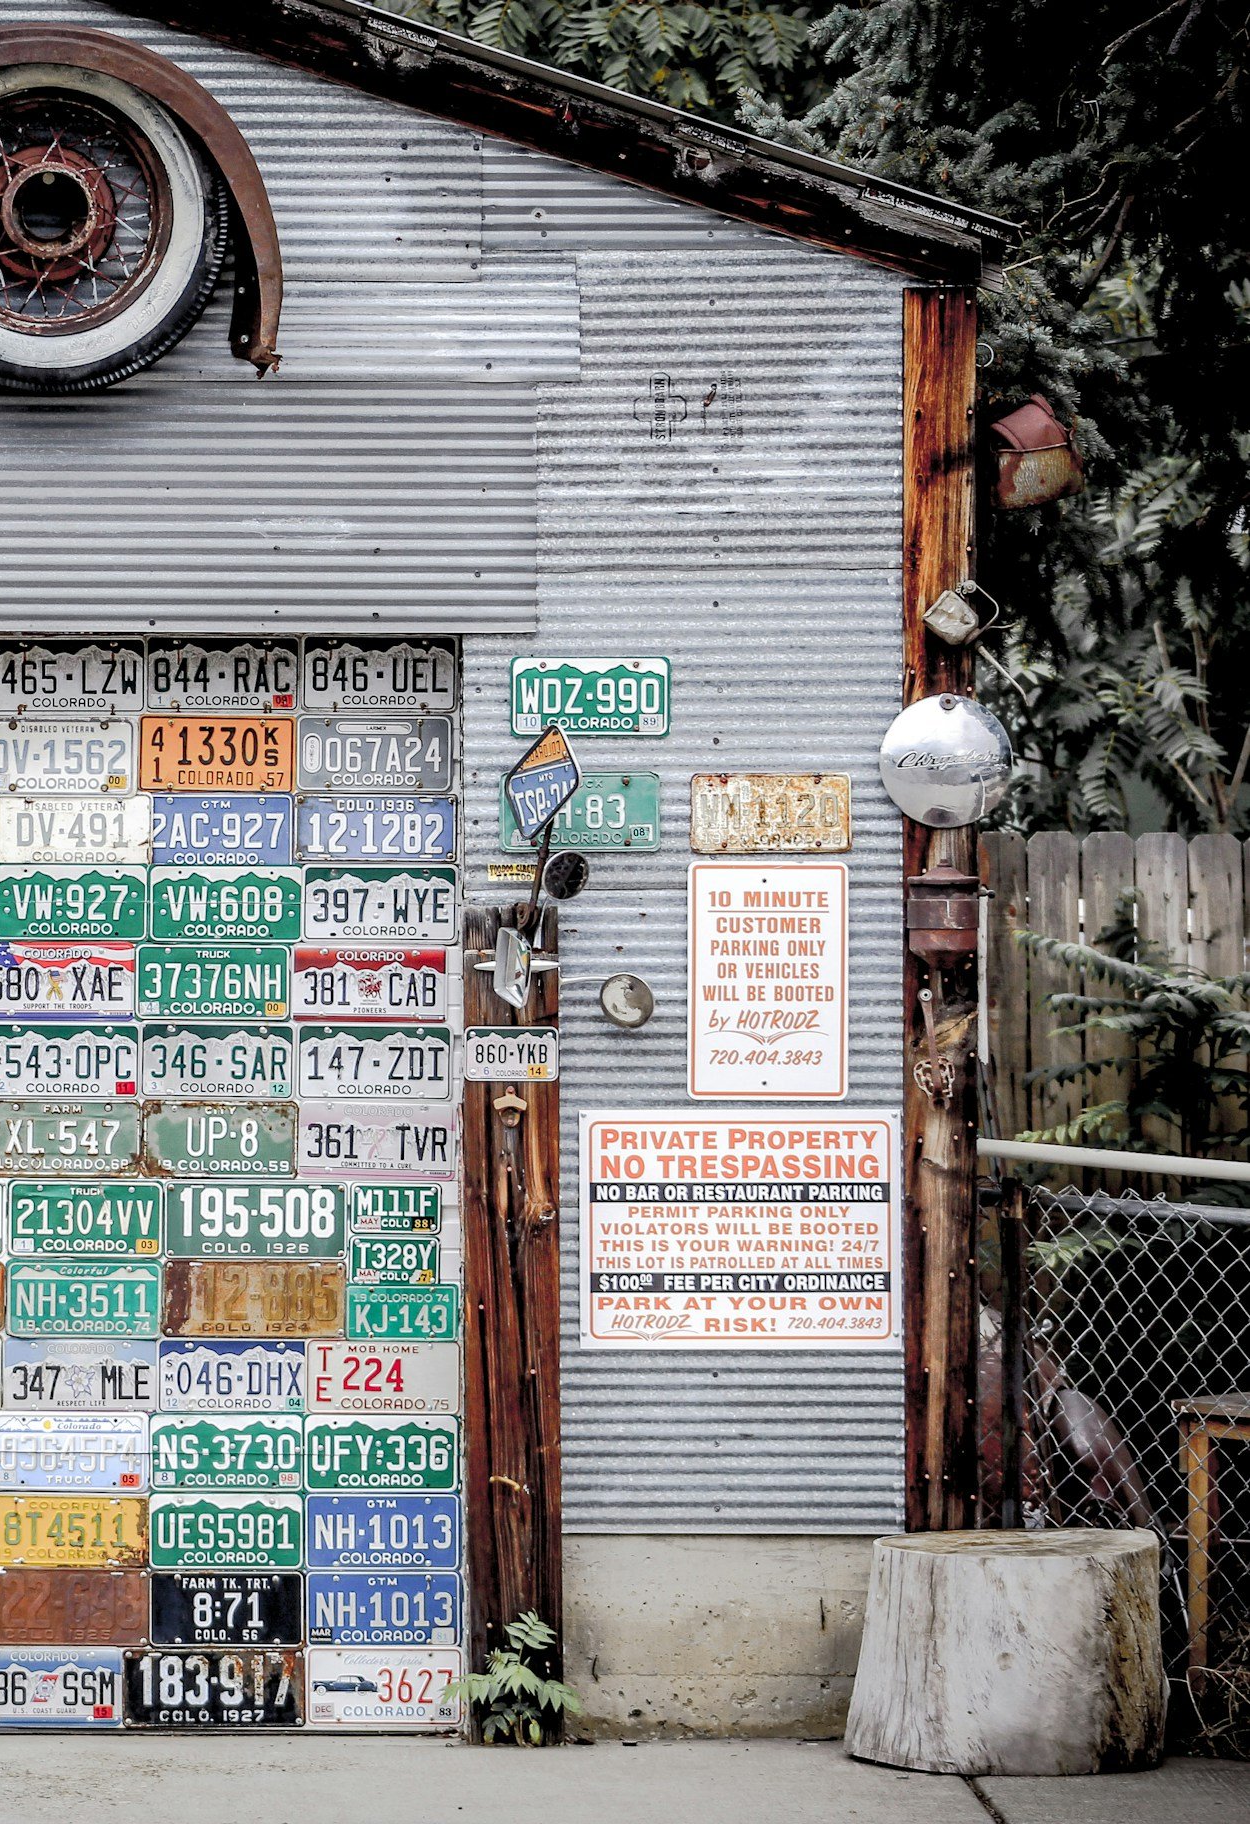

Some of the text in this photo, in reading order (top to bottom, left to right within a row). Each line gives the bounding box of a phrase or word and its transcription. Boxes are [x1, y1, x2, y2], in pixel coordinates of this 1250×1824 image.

[546, 716, 634, 730] COLORADO
[178, 727, 258, 765] 1330
[325, 736, 442, 773] 067A24
[708, 891, 829, 908] 10 MINUTE
[716, 917, 821, 934] CUSTOMER
[711, 940, 826, 956] PARKING ONLY
[717, 963, 819, 979] OR VEHICLES
[71, 968, 124, 1000] XAE
[703, 985, 834, 1002] WILL BE BOOTED
[709, 1009, 820, 1031] by HOTRODZ
[709, 1049, 823, 1065] 720.404.3843
[600, 1128, 878, 1150] PRIVATE PROPERTY
[600, 1155, 879, 1179] NO TRESPASSING
[596, 1185, 883, 1201] NO BAR OR RESTAURANT PARKING
[17, 1199, 154, 1235] 21304VV
[628, 1206, 850, 1219] PERMIT PARKING ONLY
[600, 1223, 878, 1236] VIOLATORS WILL BE BOOTED
[600, 1239, 878, 1252] THIS IS YOUR WARNING! 24/7
[357, 1242, 433, 1270] T328Y
[597, 1256, 883, 1269] THIS LOT IS PATROLLED AT ALL TIMES
[663, 1274, 694, 1291] FEE
[700, 1274, 734, 1290] PER
[739, 1274, 779, 1290] CITY
[784, 1274, 885, 1291] ORDINANCE
[598, 1296, 883, 1311] PARK AT YOUR OWN
[611, 1314, 882, 1332] HOTRODZ RISK! 720.404.3843
[343, 1357, 404, 1393] 224
[158, 1513, 295, 1550] UES5981
[182, 1578, 216, 1589] FARM
[377, 1668, 454, 1704] 3627
